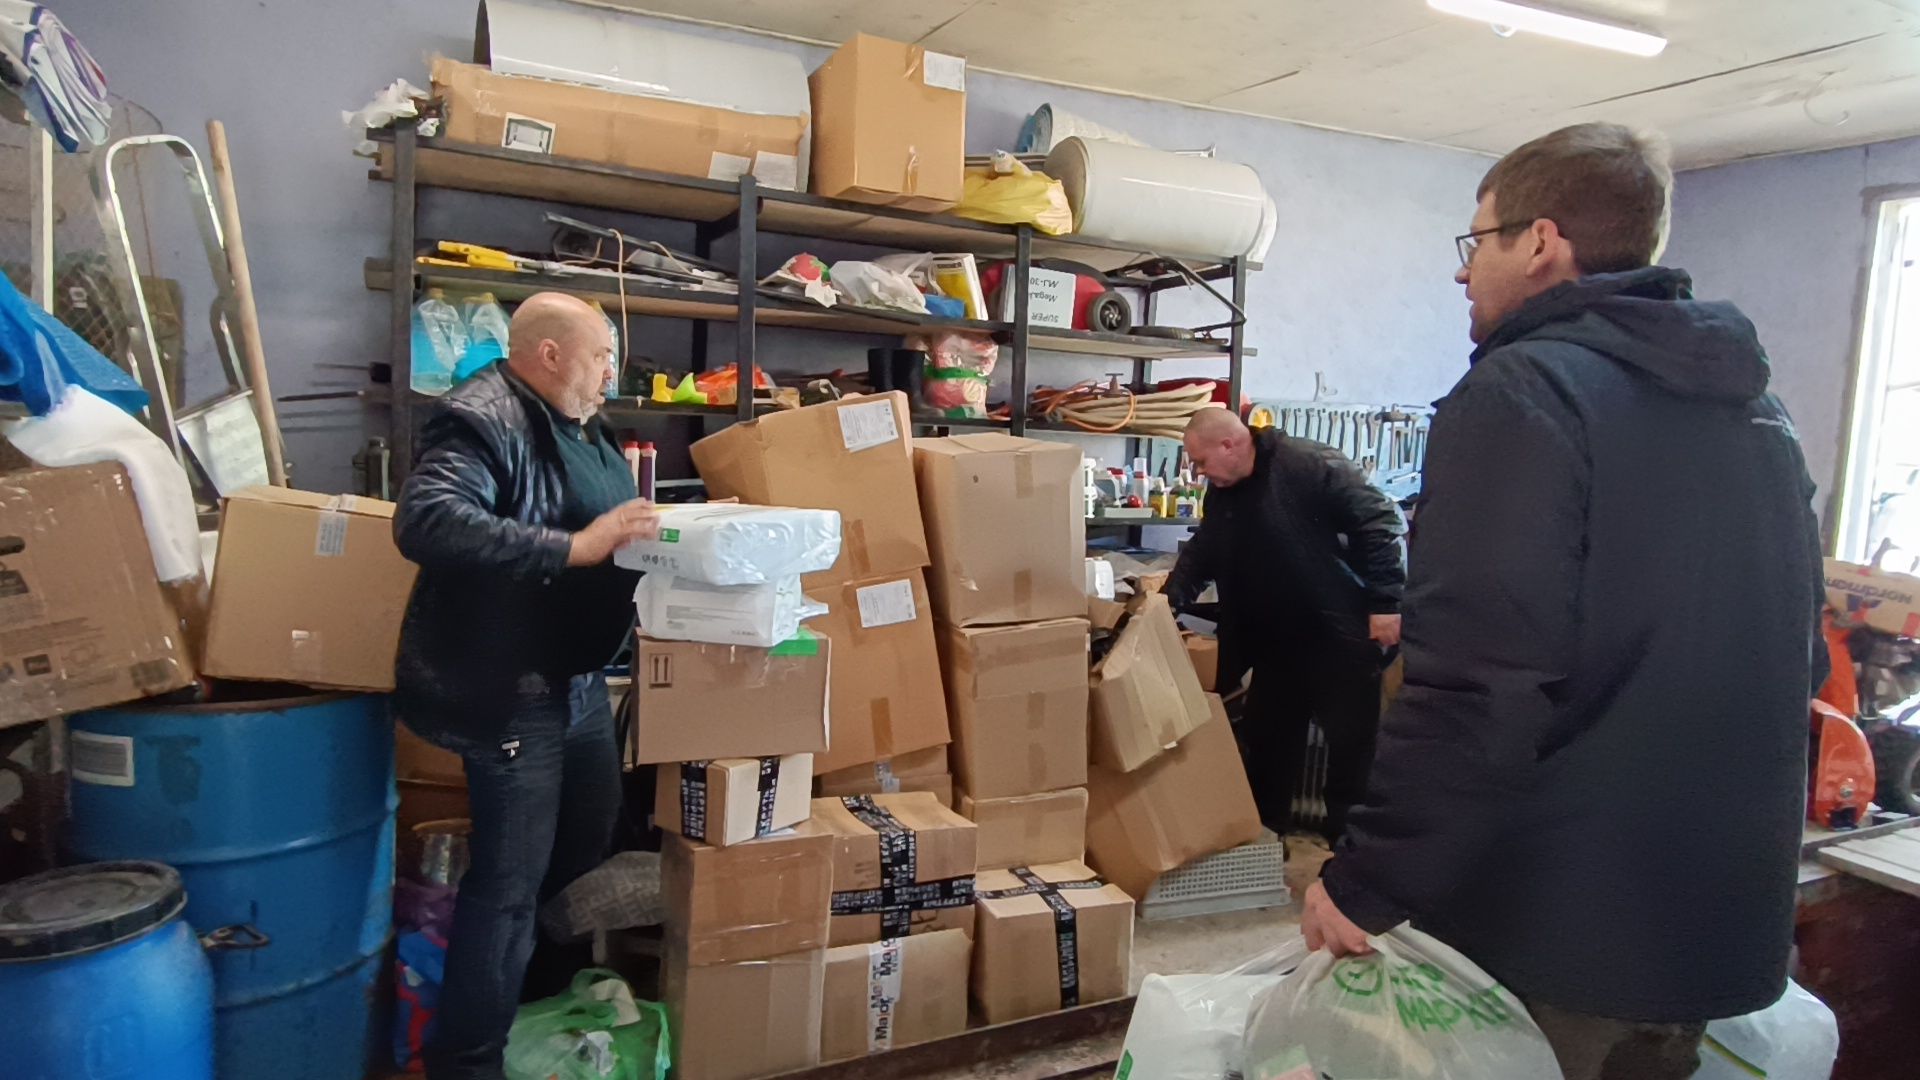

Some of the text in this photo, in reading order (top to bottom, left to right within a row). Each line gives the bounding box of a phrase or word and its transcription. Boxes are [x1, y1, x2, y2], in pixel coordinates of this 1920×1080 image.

[1029, 291, 1057, 302] MegaJ
[1032, 312, 1059, 323] SUPER
[875, 998, 889, 1041] Major
